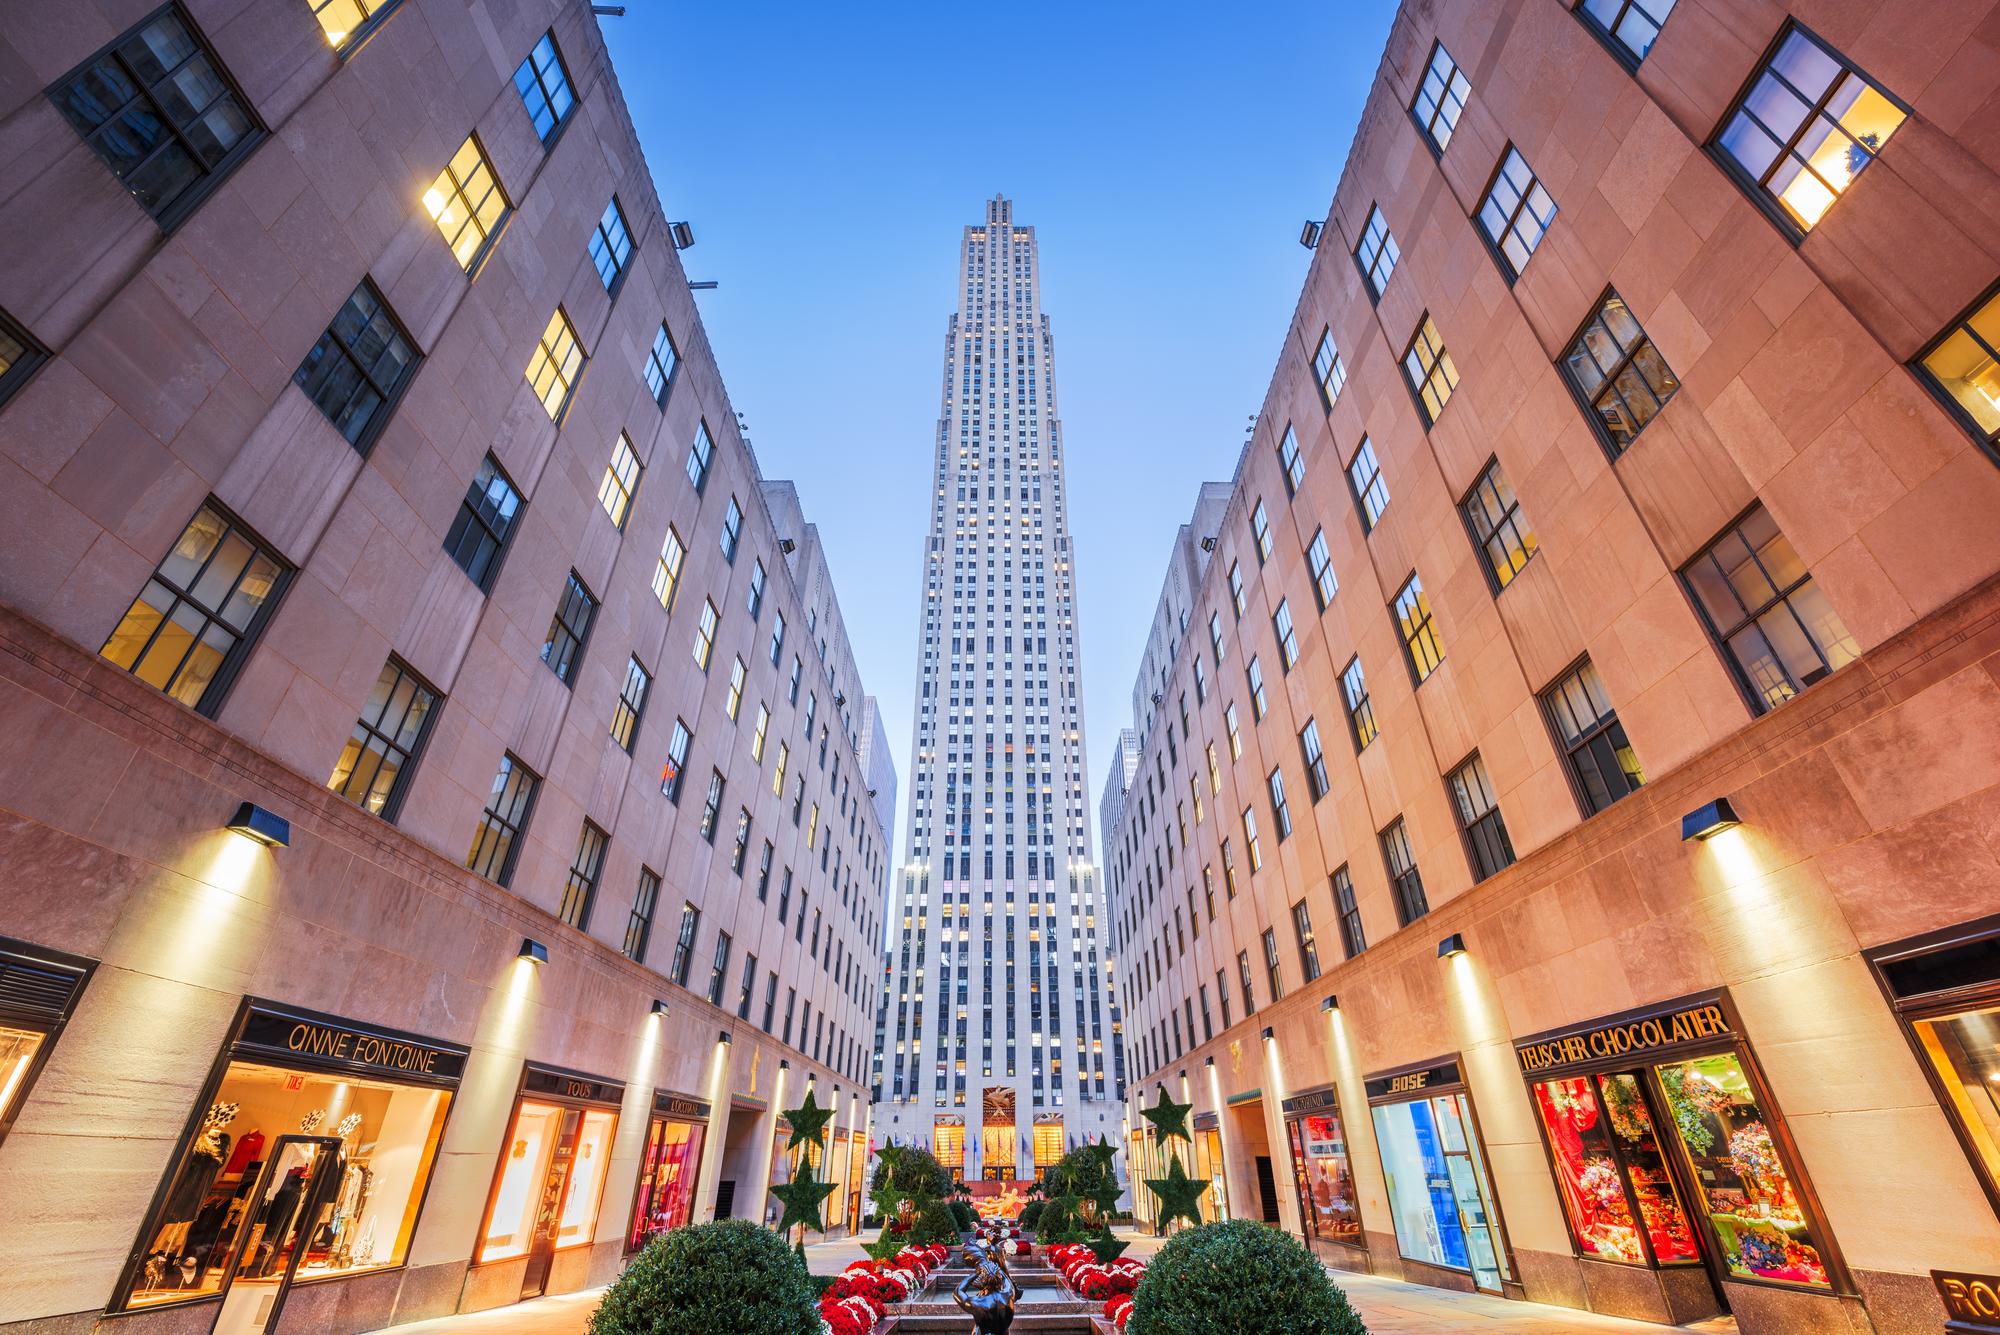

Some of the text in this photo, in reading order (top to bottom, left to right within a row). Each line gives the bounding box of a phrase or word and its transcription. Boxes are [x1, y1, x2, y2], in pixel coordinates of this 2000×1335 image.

[1519, 1005, 1730, 1070] TEUSCHER CHOCOLATIER
[567, 1081, 592, 1098] TOUS
[1387, 1071, 1430, 1094] BOSE
[1942, 1278, 2000, 1318] RO
